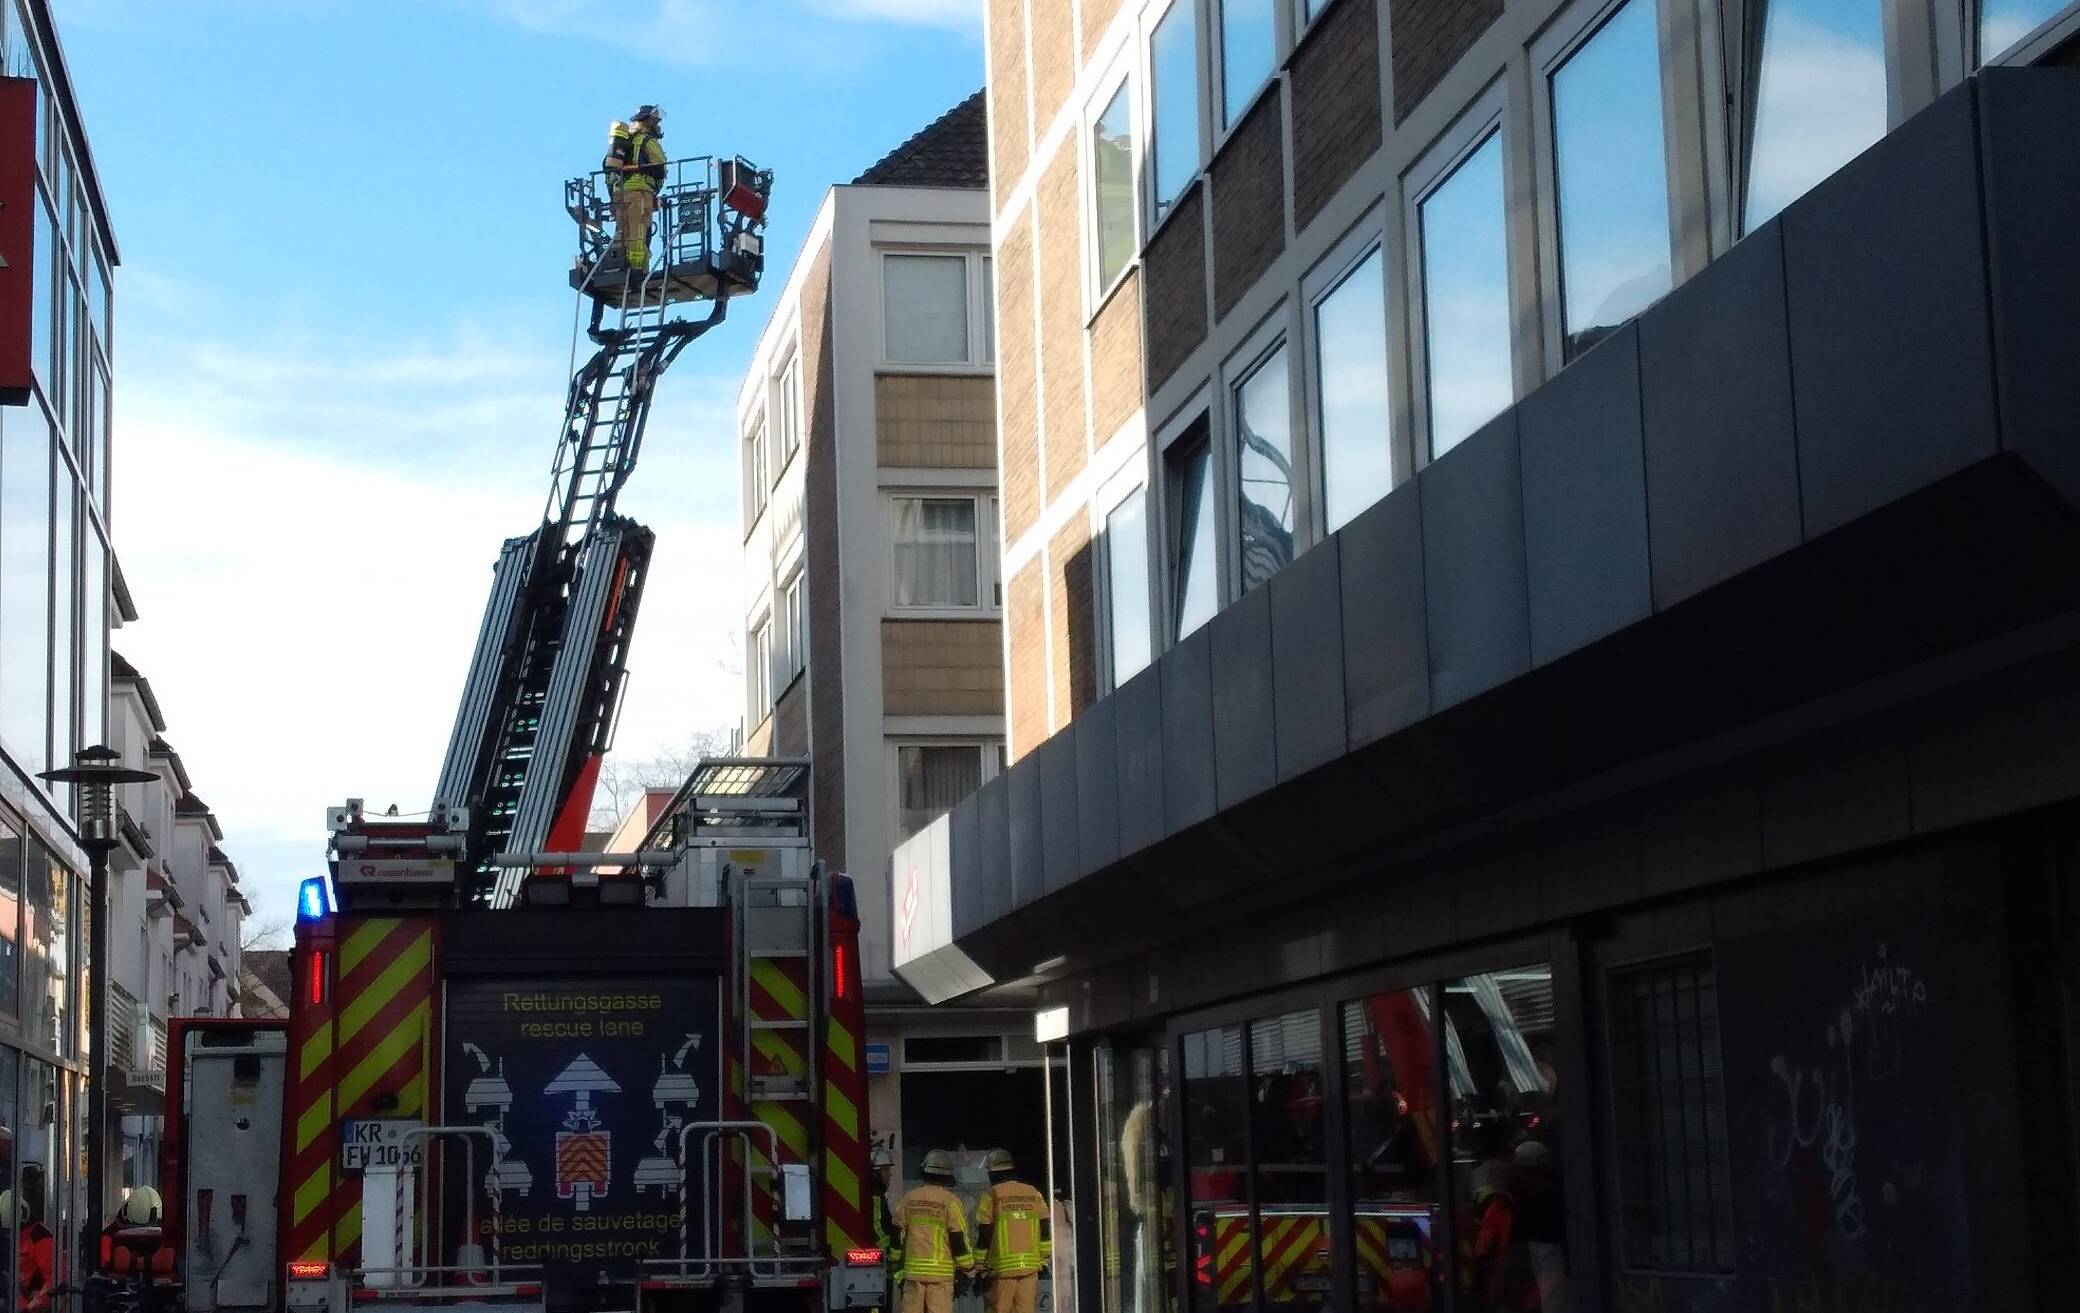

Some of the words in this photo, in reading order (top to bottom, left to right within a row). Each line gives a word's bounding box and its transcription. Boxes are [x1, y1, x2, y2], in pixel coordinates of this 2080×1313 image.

[504, 992, 663, 1015] Rettungsgasse
[520, 1022, 593, 1038] rescue
[600, 1020, 644, 1037] lane
[355, 1123, 382, 1143] KR
[347, 1145, 370, 1166] FW
[538, 1213, 565, 1232] de
[572, 1211, 681, 1233] sauvetage
